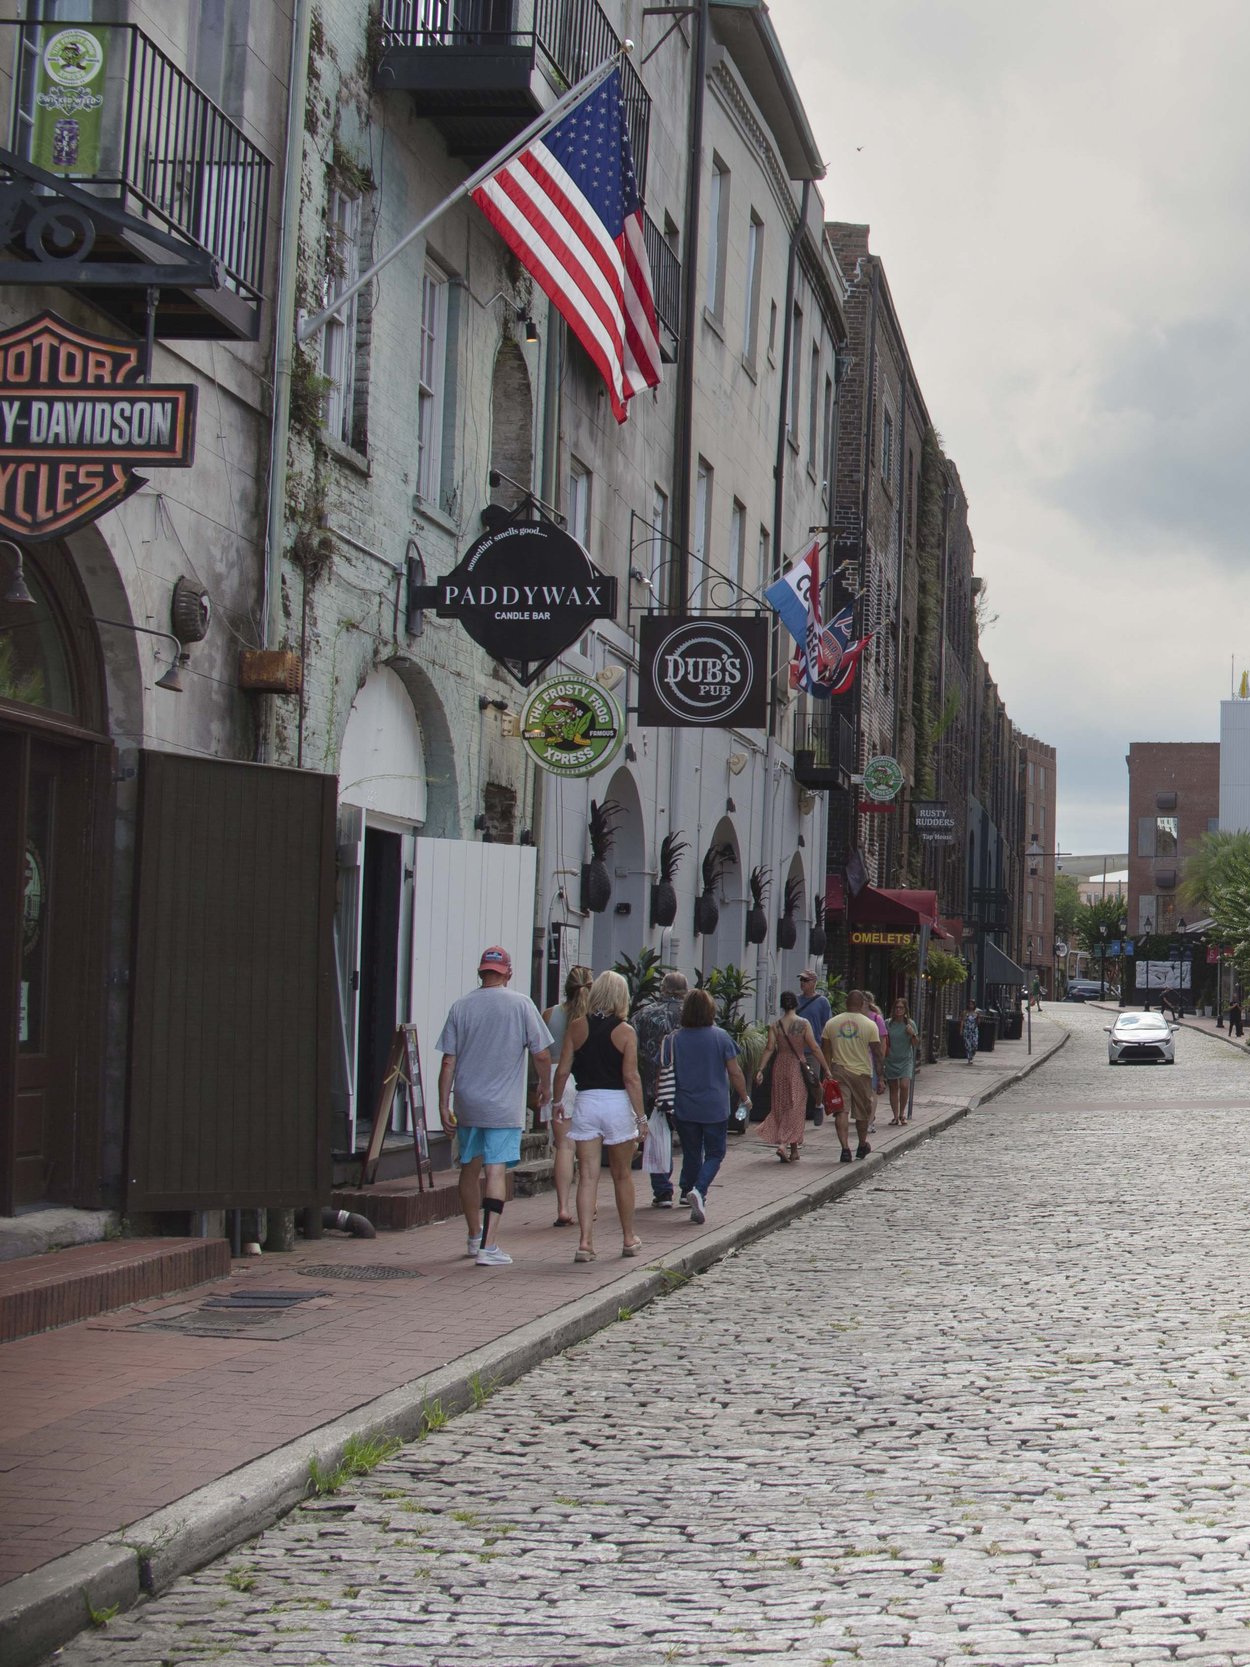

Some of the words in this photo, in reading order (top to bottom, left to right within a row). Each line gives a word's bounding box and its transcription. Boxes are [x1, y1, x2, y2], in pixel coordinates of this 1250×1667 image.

[0, 332, 113, 384] OTOR
[467, 536, 494, 572] somethin'
[493, 527, 519, 542] smells
[445, 586, 602, 605] PADDYWAX
[495, 611, 530, 620] CANDLE
[532, 611, 551, 620] BAR
[664, 654, 741, 683] DUB'S
[699, 685, 731, 696] PUB
[529, 700, 545, 724] THE
[542, 684, 590, 703] FROSTY
[588, 693, 609, 724] FROG
[543, 746, 594, 765] XPRESS
[915, 818, 955, 826] RUDDERS
[920, 809, 947, 818] RUSTY
[852, 932, 911, 944] OMELETS
